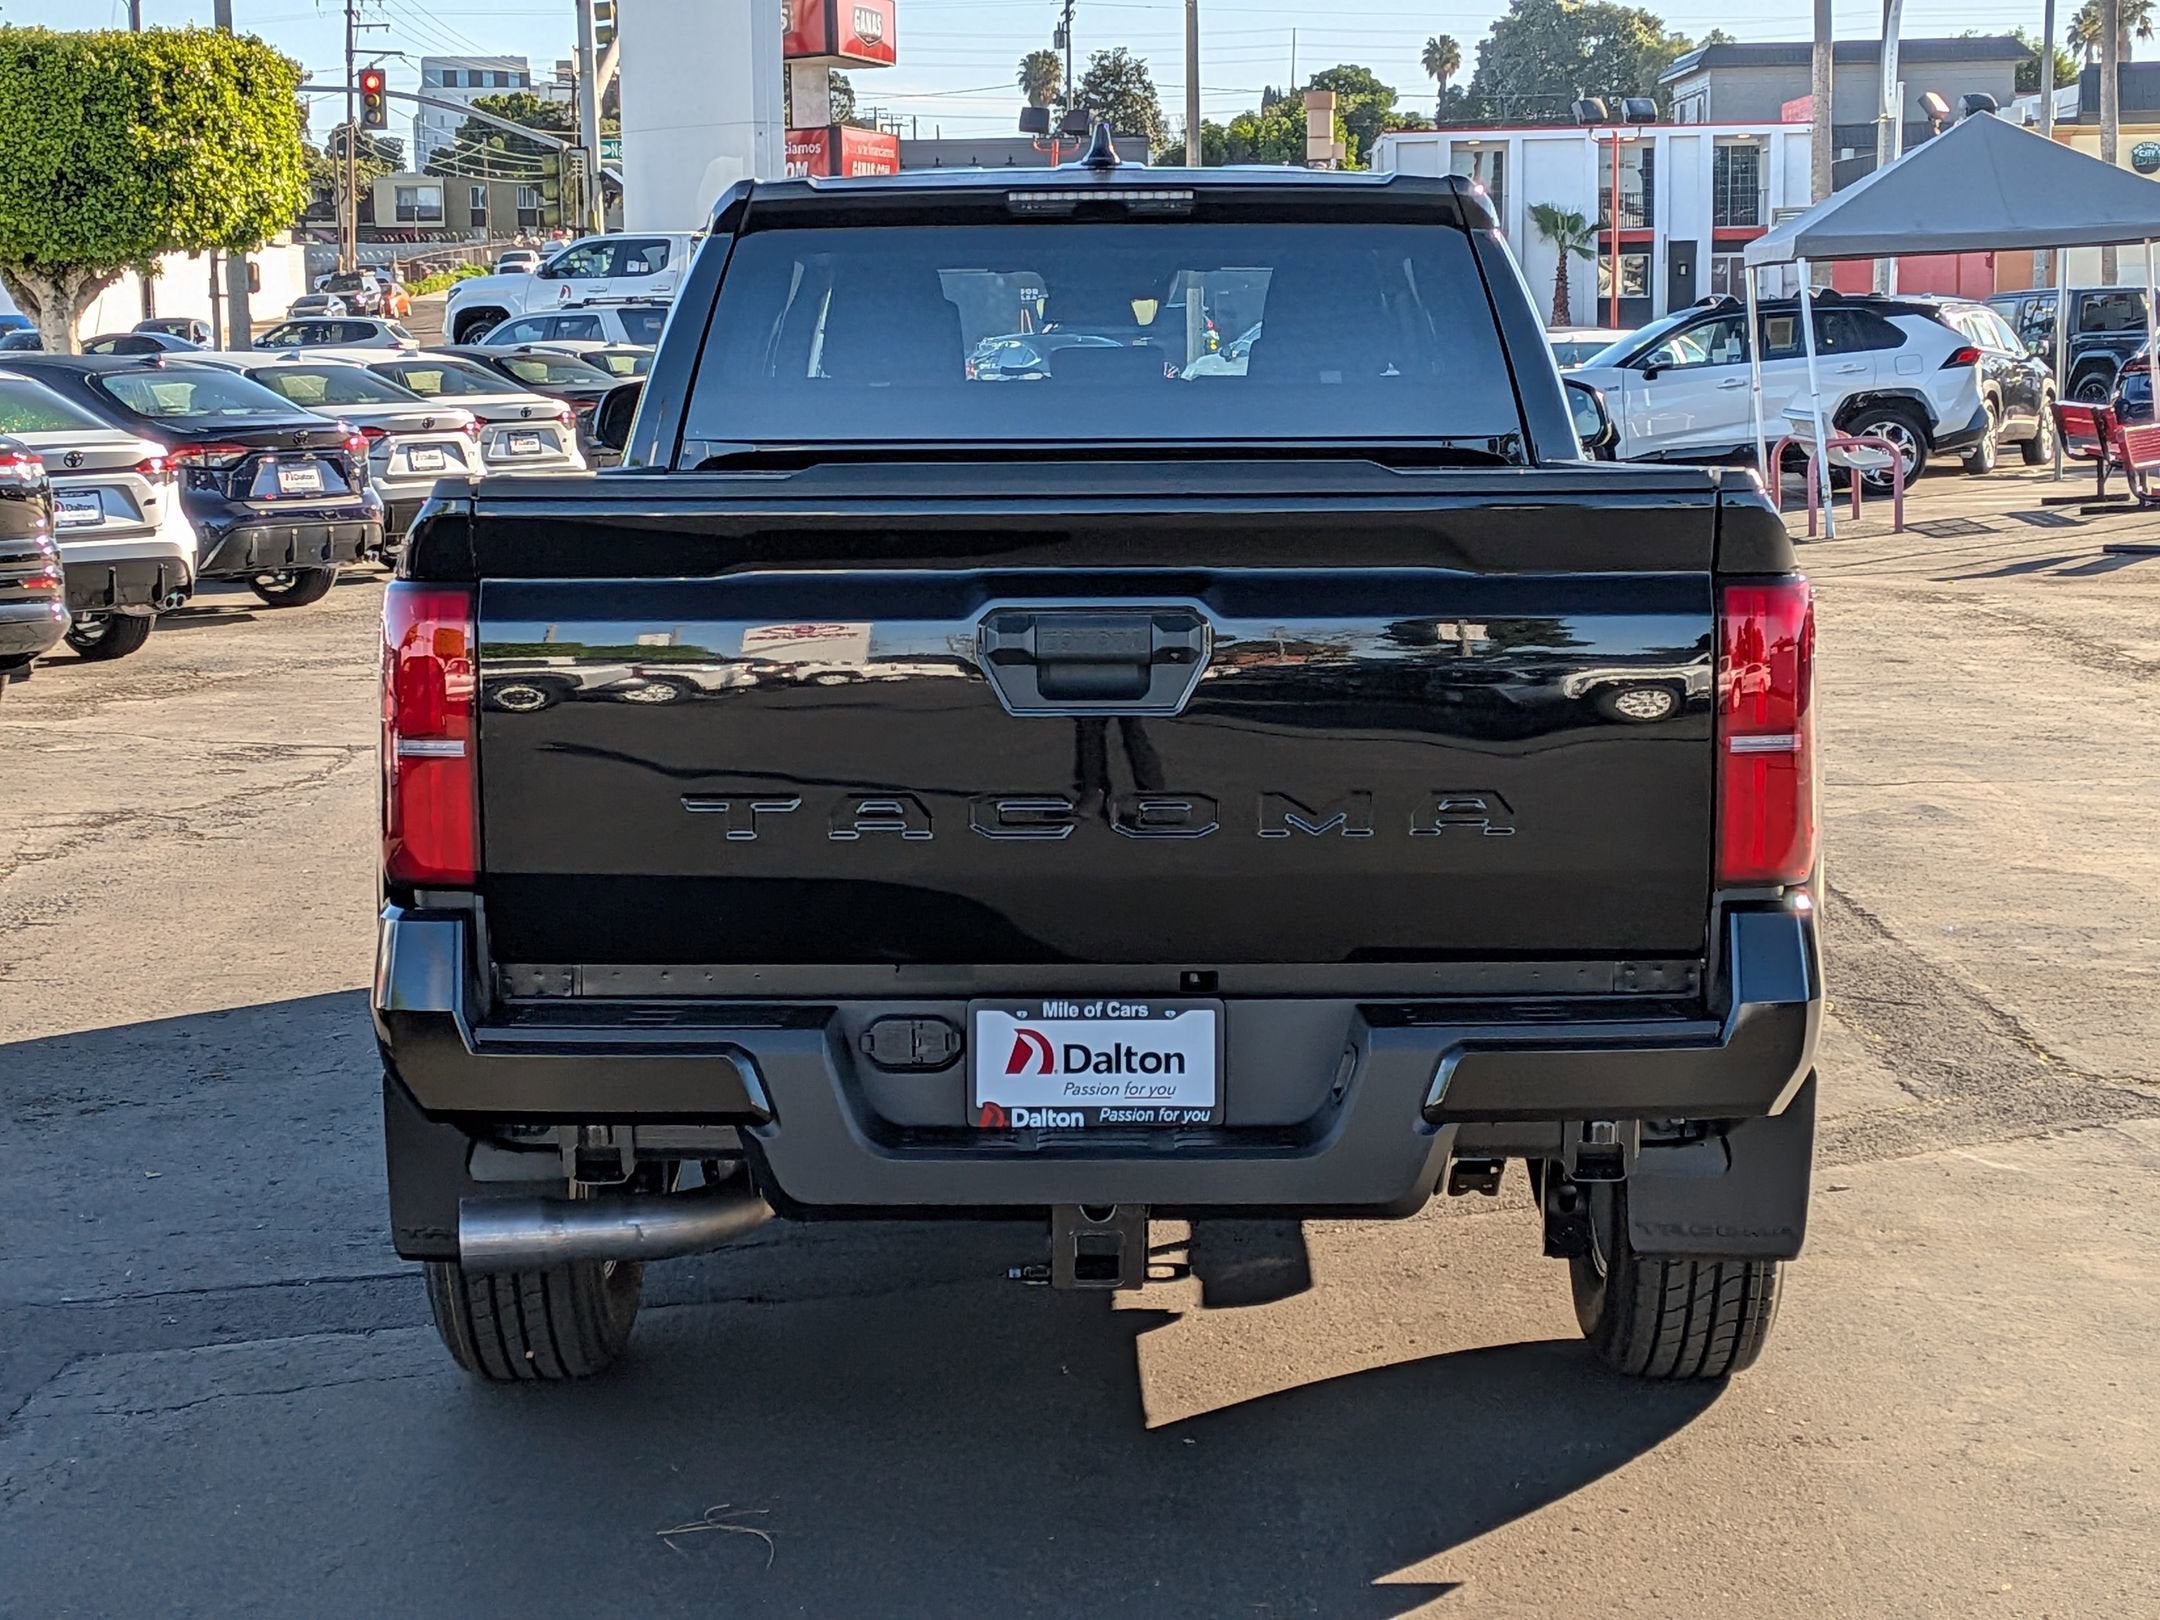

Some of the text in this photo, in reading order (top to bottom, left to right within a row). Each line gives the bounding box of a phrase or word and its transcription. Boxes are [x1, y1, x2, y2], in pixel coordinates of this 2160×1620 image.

[854, 8, 882, 36] GANAS
[65, 503, 96, 512] Dalton
[681, 790, 1515, 840] TACOMA
[1042, 1001, 1149, 1018] Mile of Cars
[1063, 1043, 1185, 1075] Dalton
[1063, 1081, 1177, 1098] Passion for you
[1011, 1108, 1211, 1128] Dalton Passion for you
